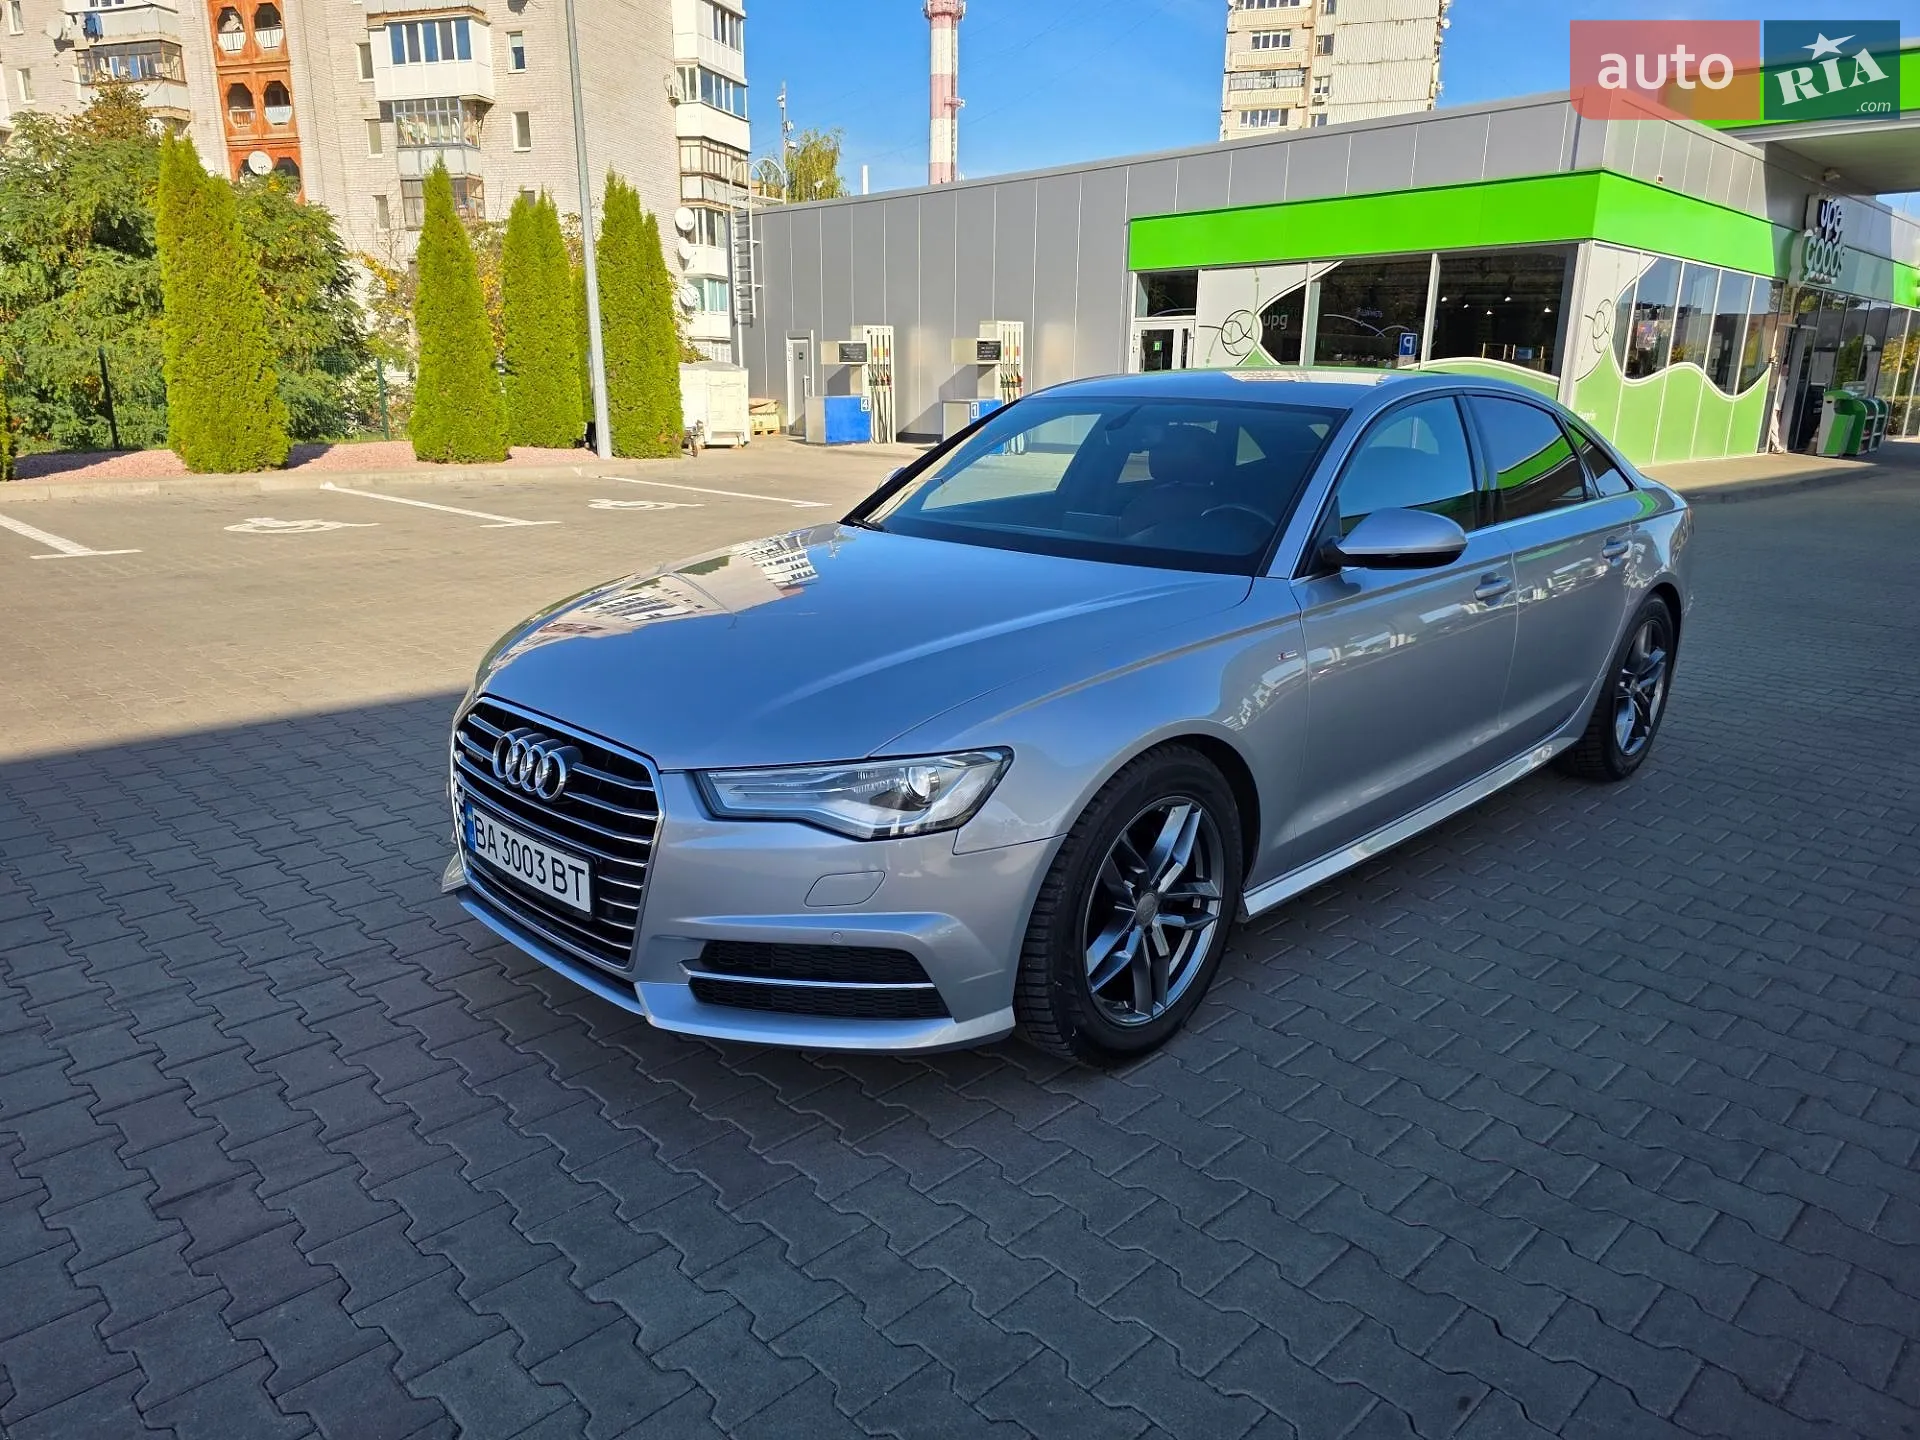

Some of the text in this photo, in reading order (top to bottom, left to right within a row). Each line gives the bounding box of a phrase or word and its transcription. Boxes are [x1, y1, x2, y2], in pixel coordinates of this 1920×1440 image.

[1263, 314, 1288, 331] upg
[474, 814, 586, 902] BA 3003 BT
